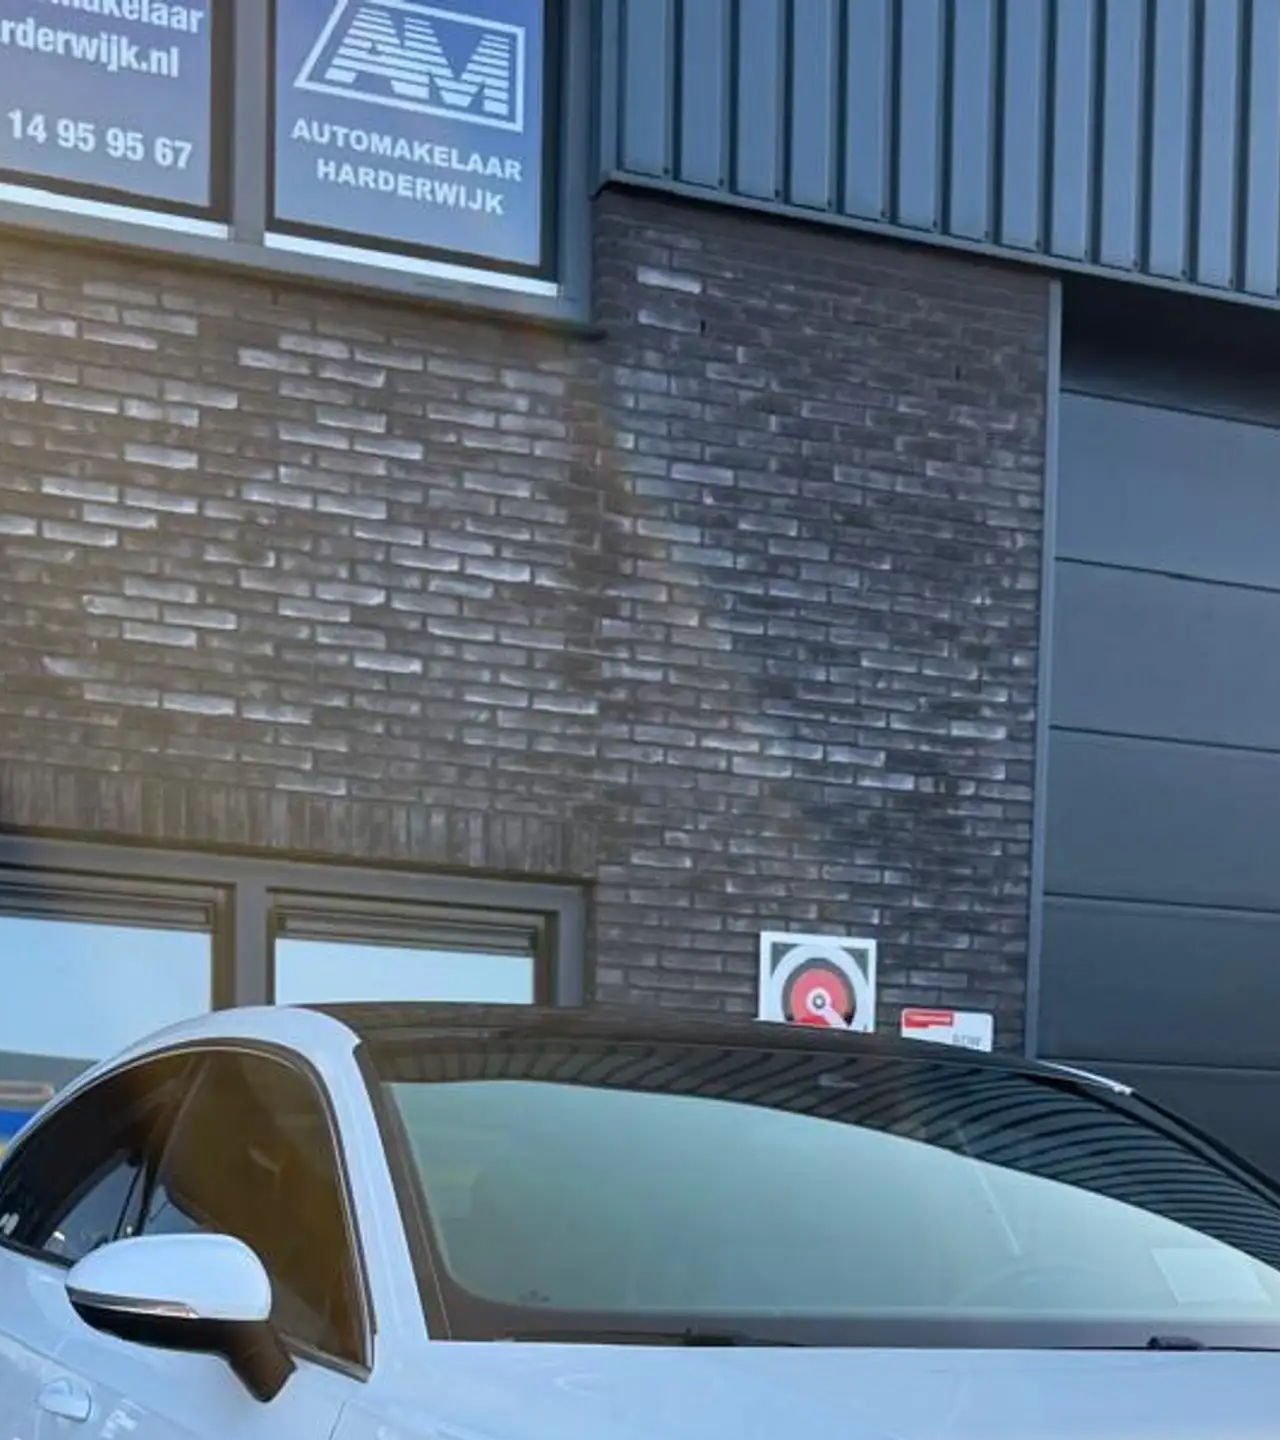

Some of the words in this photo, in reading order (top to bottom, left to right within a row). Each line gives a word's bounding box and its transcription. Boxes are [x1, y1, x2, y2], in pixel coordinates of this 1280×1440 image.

[7, 108, 47, 143] 14
[56, 118, 96, 153] 95
[105, 127, 145, 162] 95
[153, 136, 194, 171] 67
[291, 118, 522, 183] AUTOMAKELAAR
[316, 158, 505, 216] HARDERWIJK
